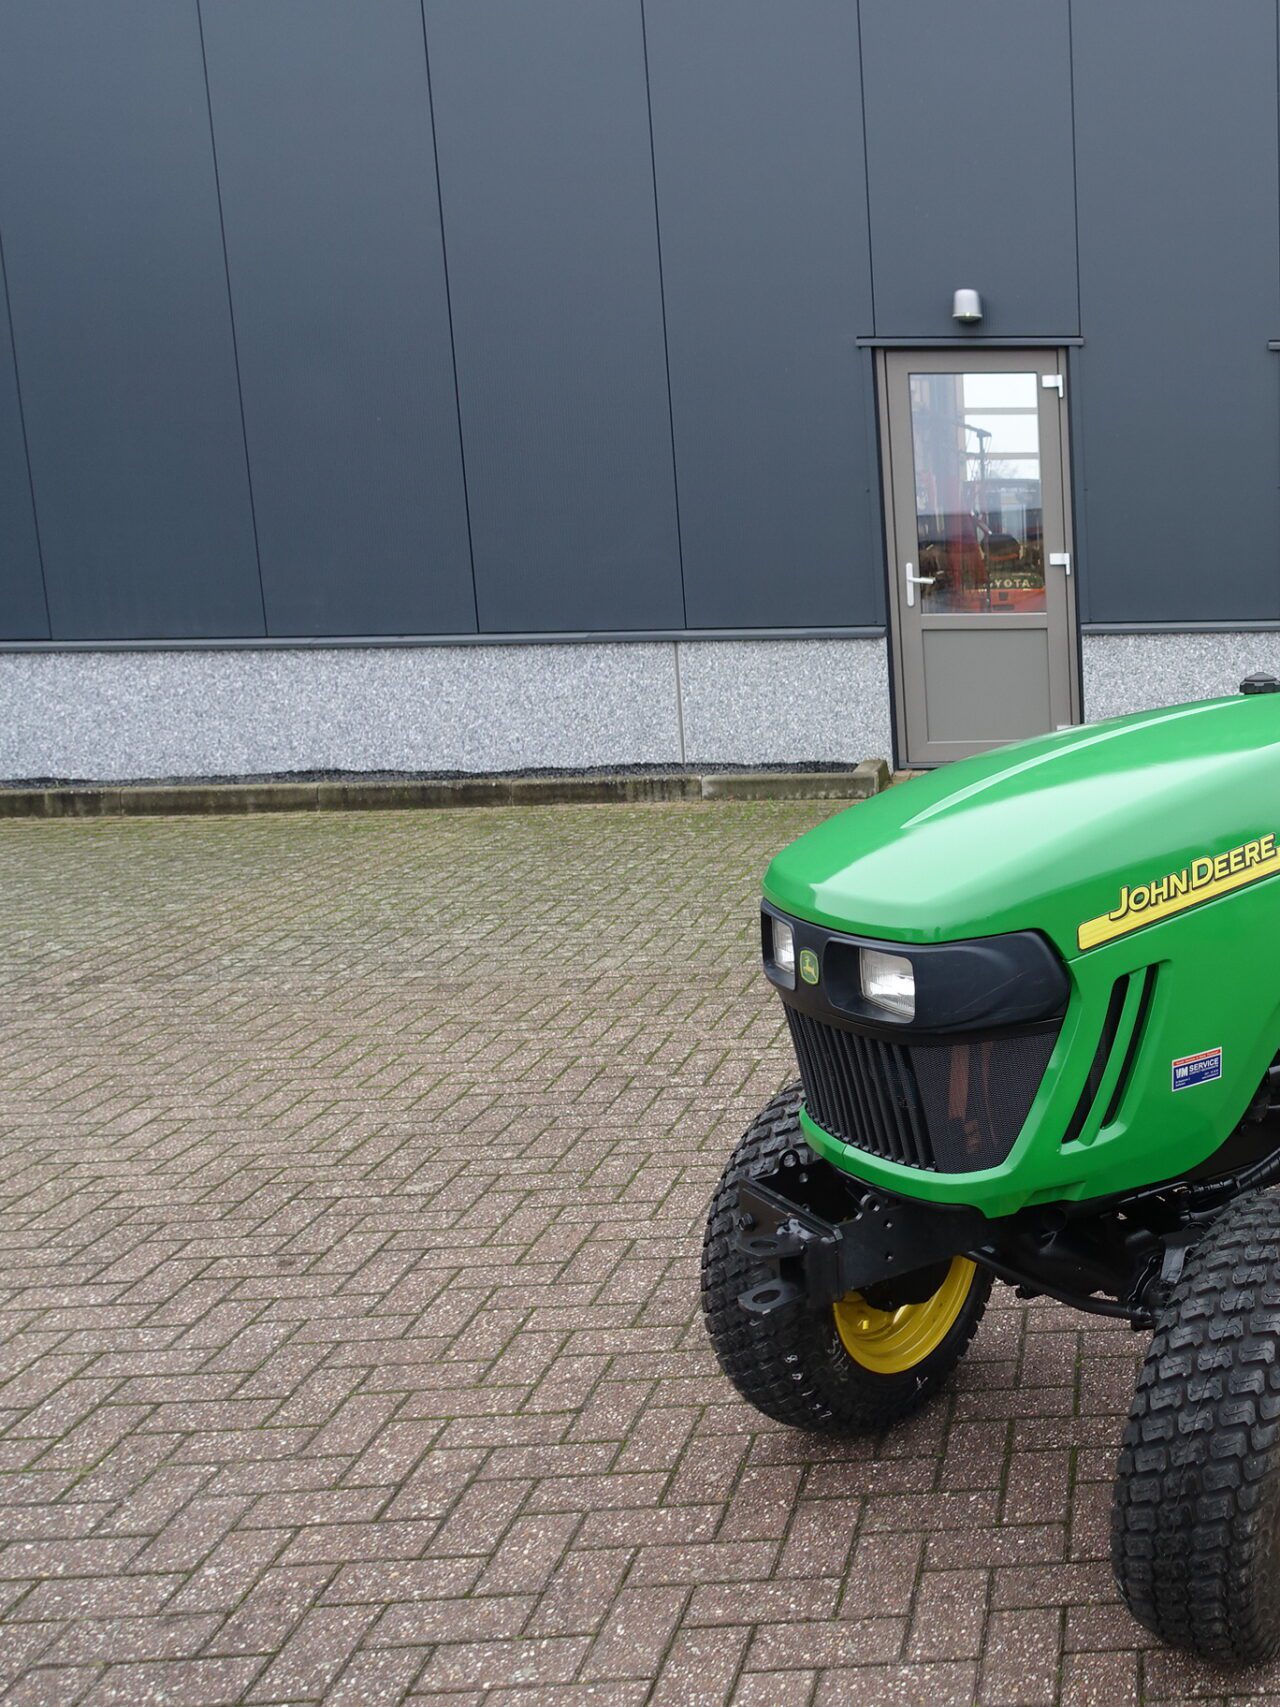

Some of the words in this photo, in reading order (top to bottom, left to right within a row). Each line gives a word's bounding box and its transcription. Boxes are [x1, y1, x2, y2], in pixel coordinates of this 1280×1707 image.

[1108, 868, 1189, 921] JOHN
[1191, 833, 1277, 889] DEERE
[1175, 1066, 1189, 1079] VM
[1189, 1057, 1219, 1072] SERVICE
